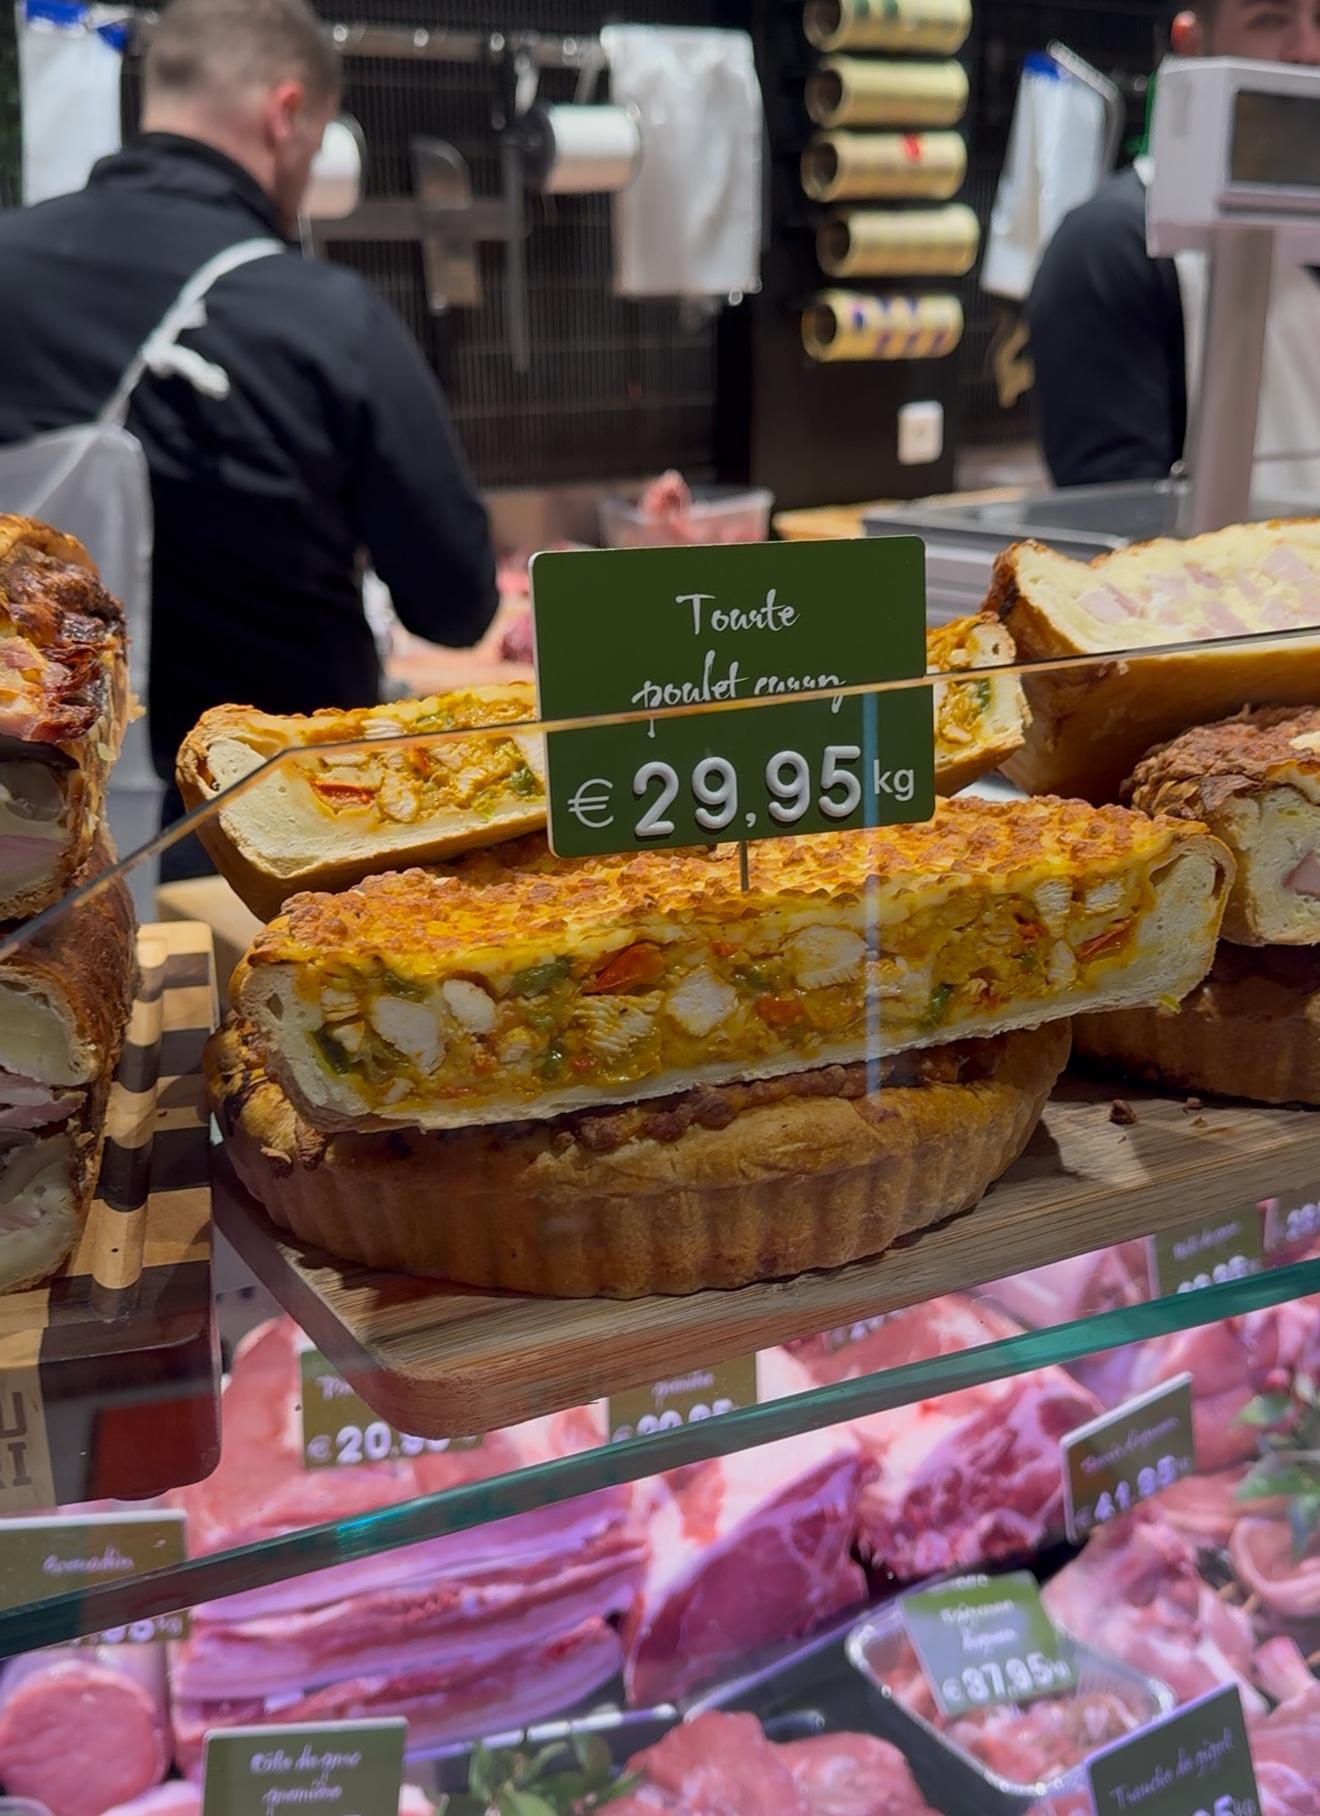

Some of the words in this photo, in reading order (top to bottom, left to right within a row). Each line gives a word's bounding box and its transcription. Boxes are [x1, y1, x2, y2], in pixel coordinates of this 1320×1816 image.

[676, 589, 800, 635] Tourte
[631, 650, 749, 738] poulet
[567, 778, 614, 828] €
[632, 745, 861, 838] 29,95
[873, 759, 915, 801] kg
